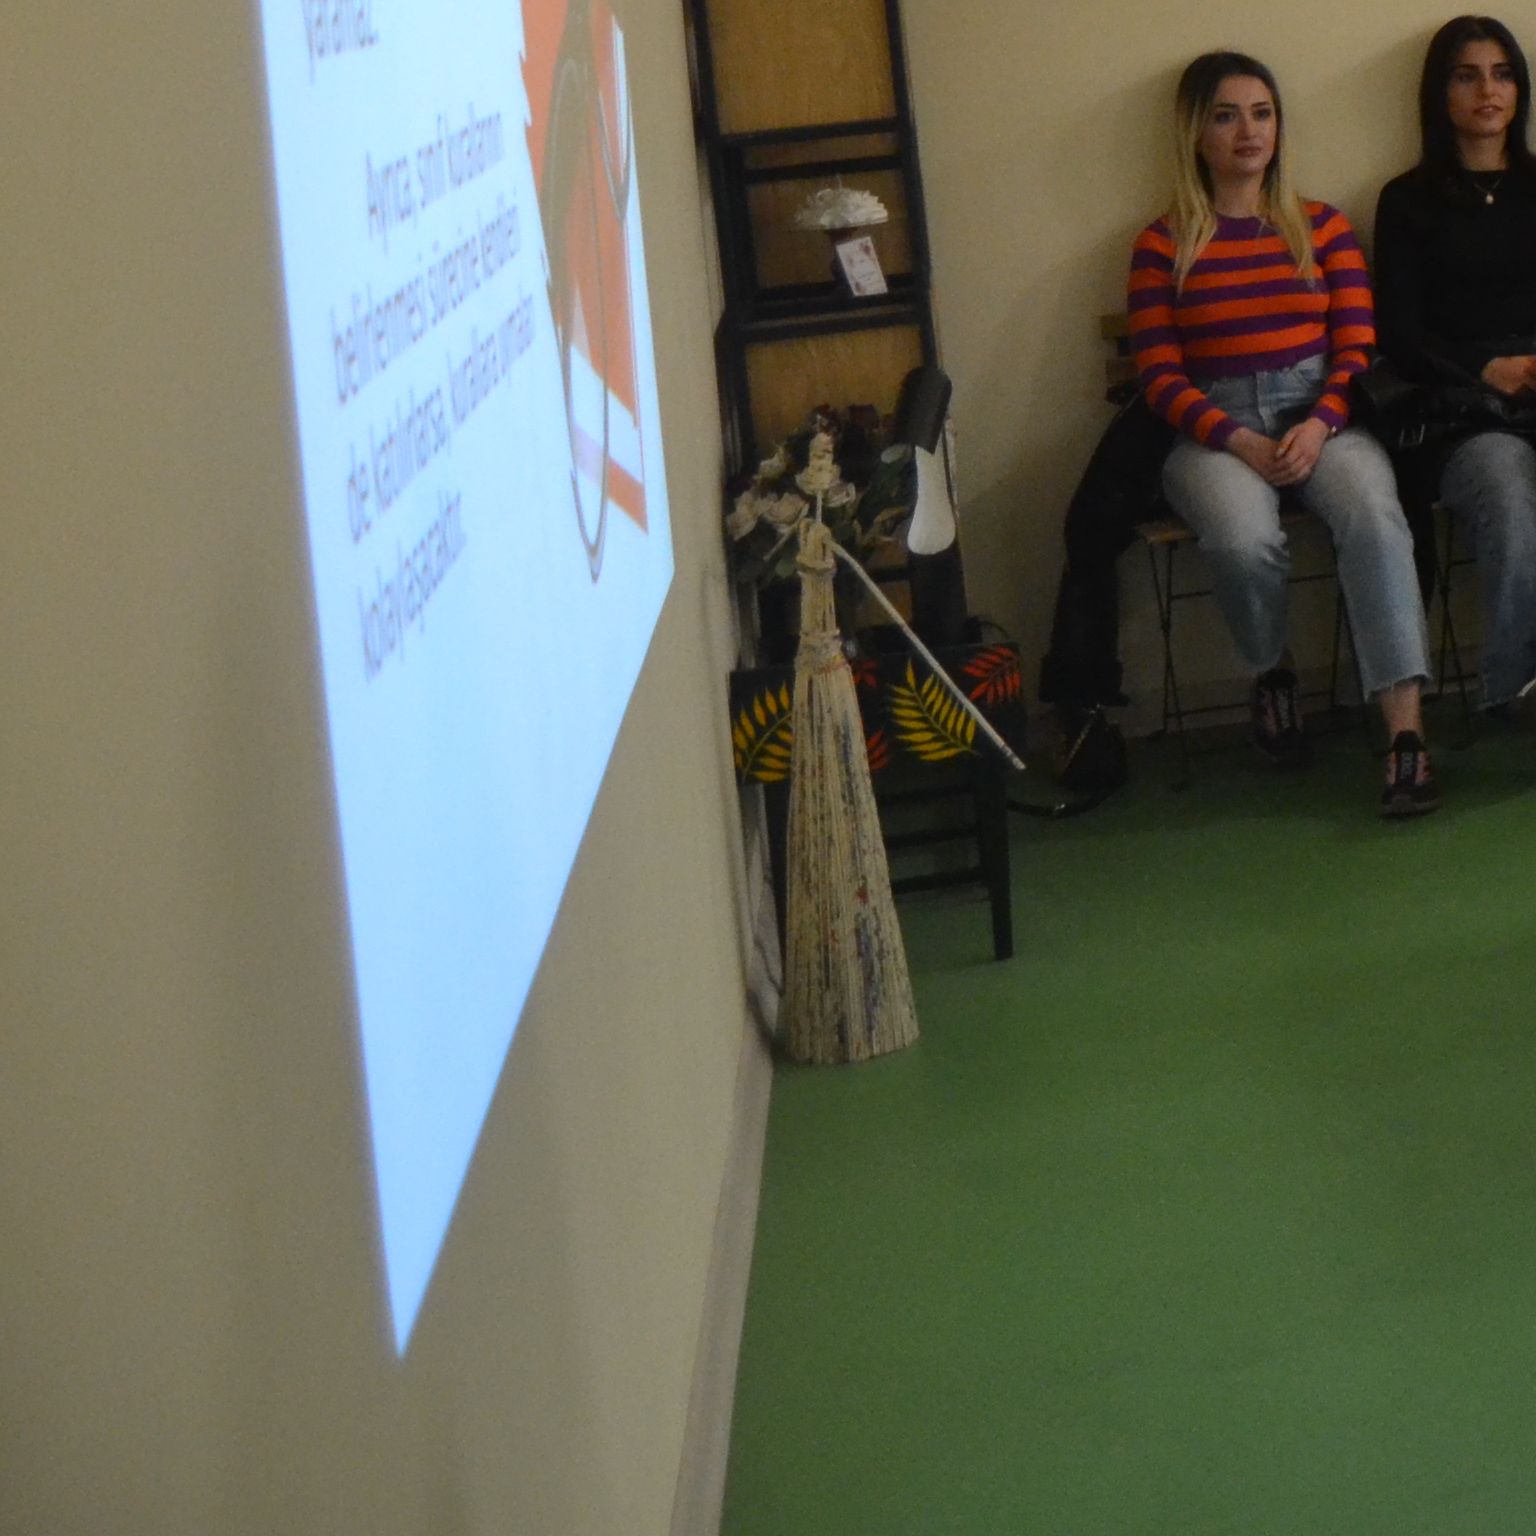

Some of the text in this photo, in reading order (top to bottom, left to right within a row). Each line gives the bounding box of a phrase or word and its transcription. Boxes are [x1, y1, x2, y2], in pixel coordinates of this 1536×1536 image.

[366, 153, 416, 252] Ayrıca,
[416, 115, 447, 210] sınıf
[331, 256, 427, 406] belirlenmesi
[428, 229, 481, 326] sürecine
[347, 445, 371, 545] de
[449, 328, 499, 427] kurallara
